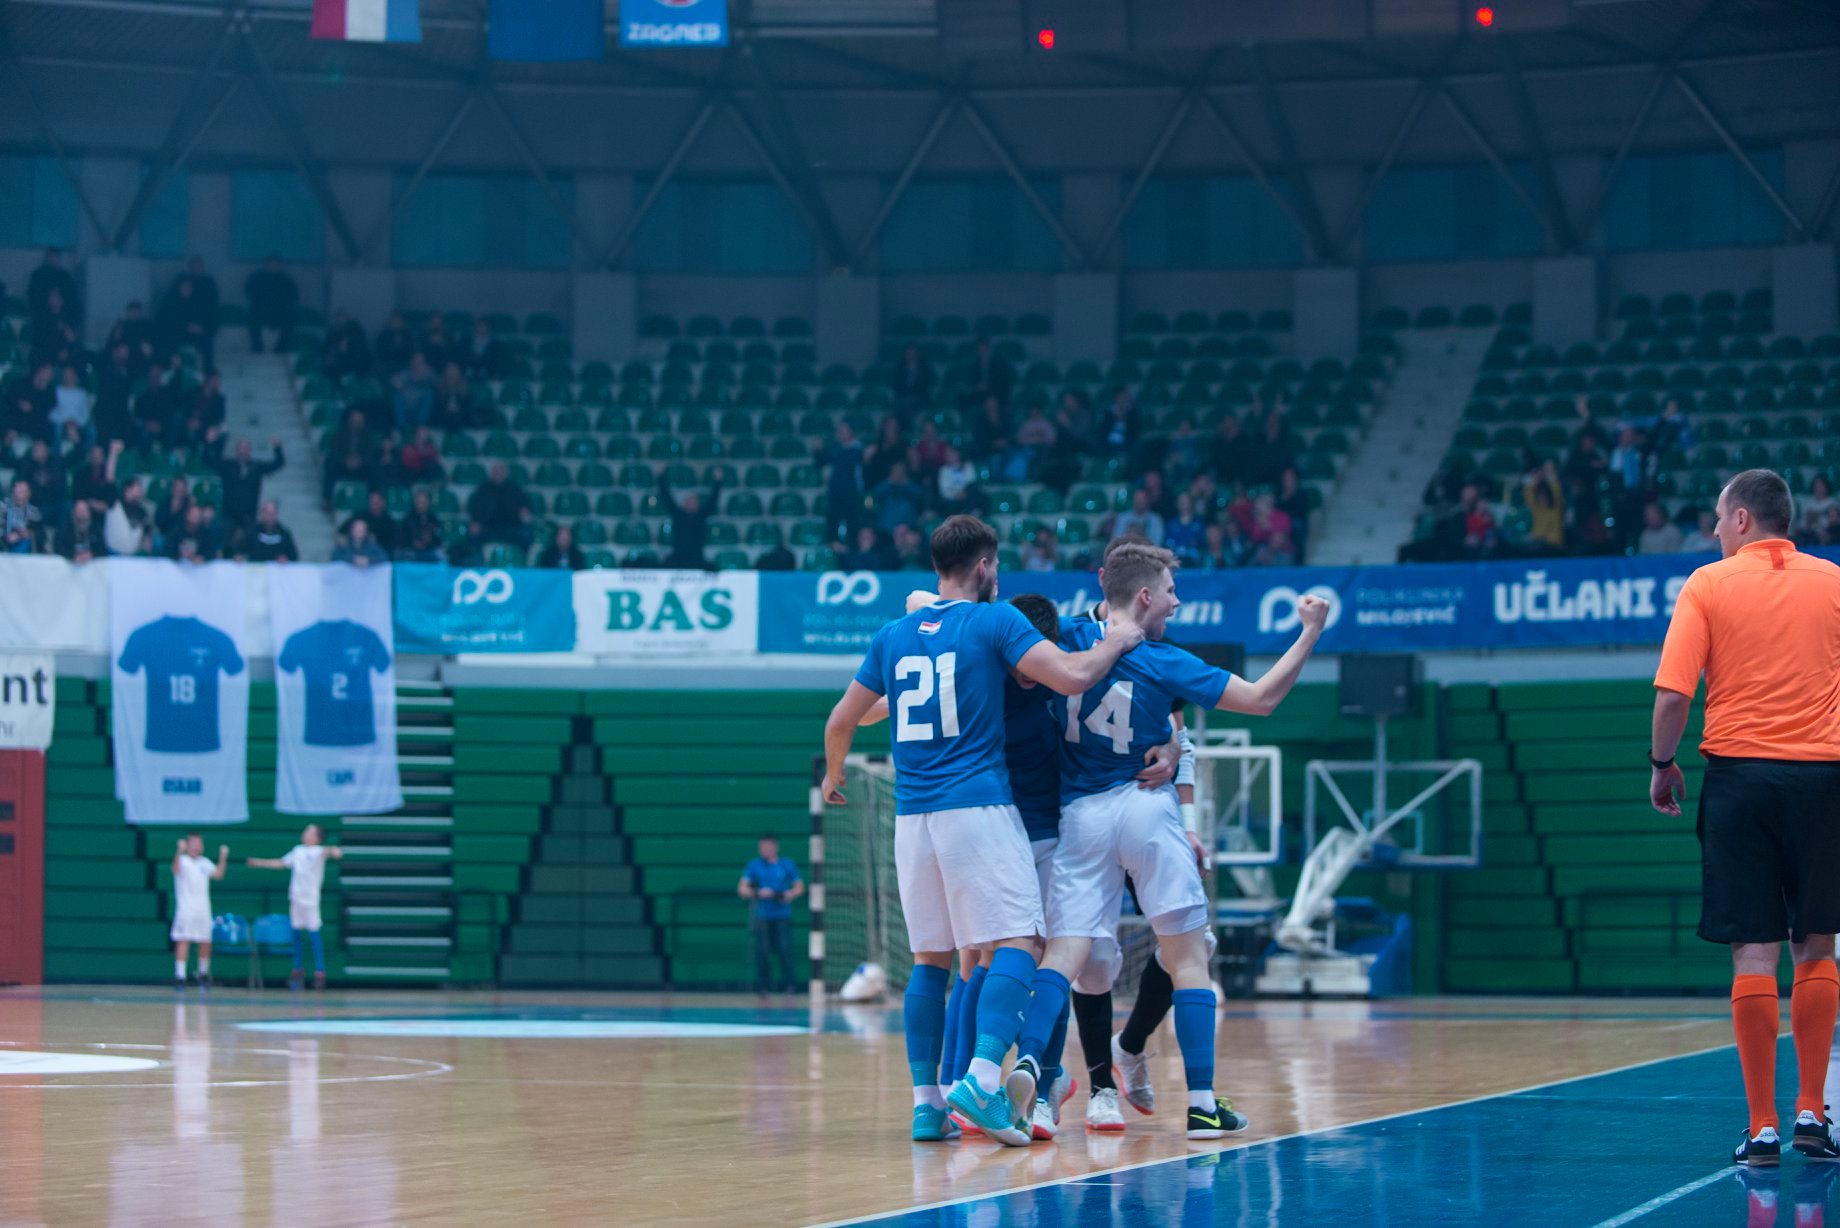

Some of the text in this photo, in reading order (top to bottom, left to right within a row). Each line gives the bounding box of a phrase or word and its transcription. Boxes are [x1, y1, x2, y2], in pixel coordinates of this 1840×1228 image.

[605, 588, 733, 631] BAS
[1494, 570, 1656, 622] UČLANI
[170, 674, 196, 704] 18
[331, 672, 348, 700] 2
[895, 652, 960, 743] 21
[1064, 681, 1134, 755] 14
